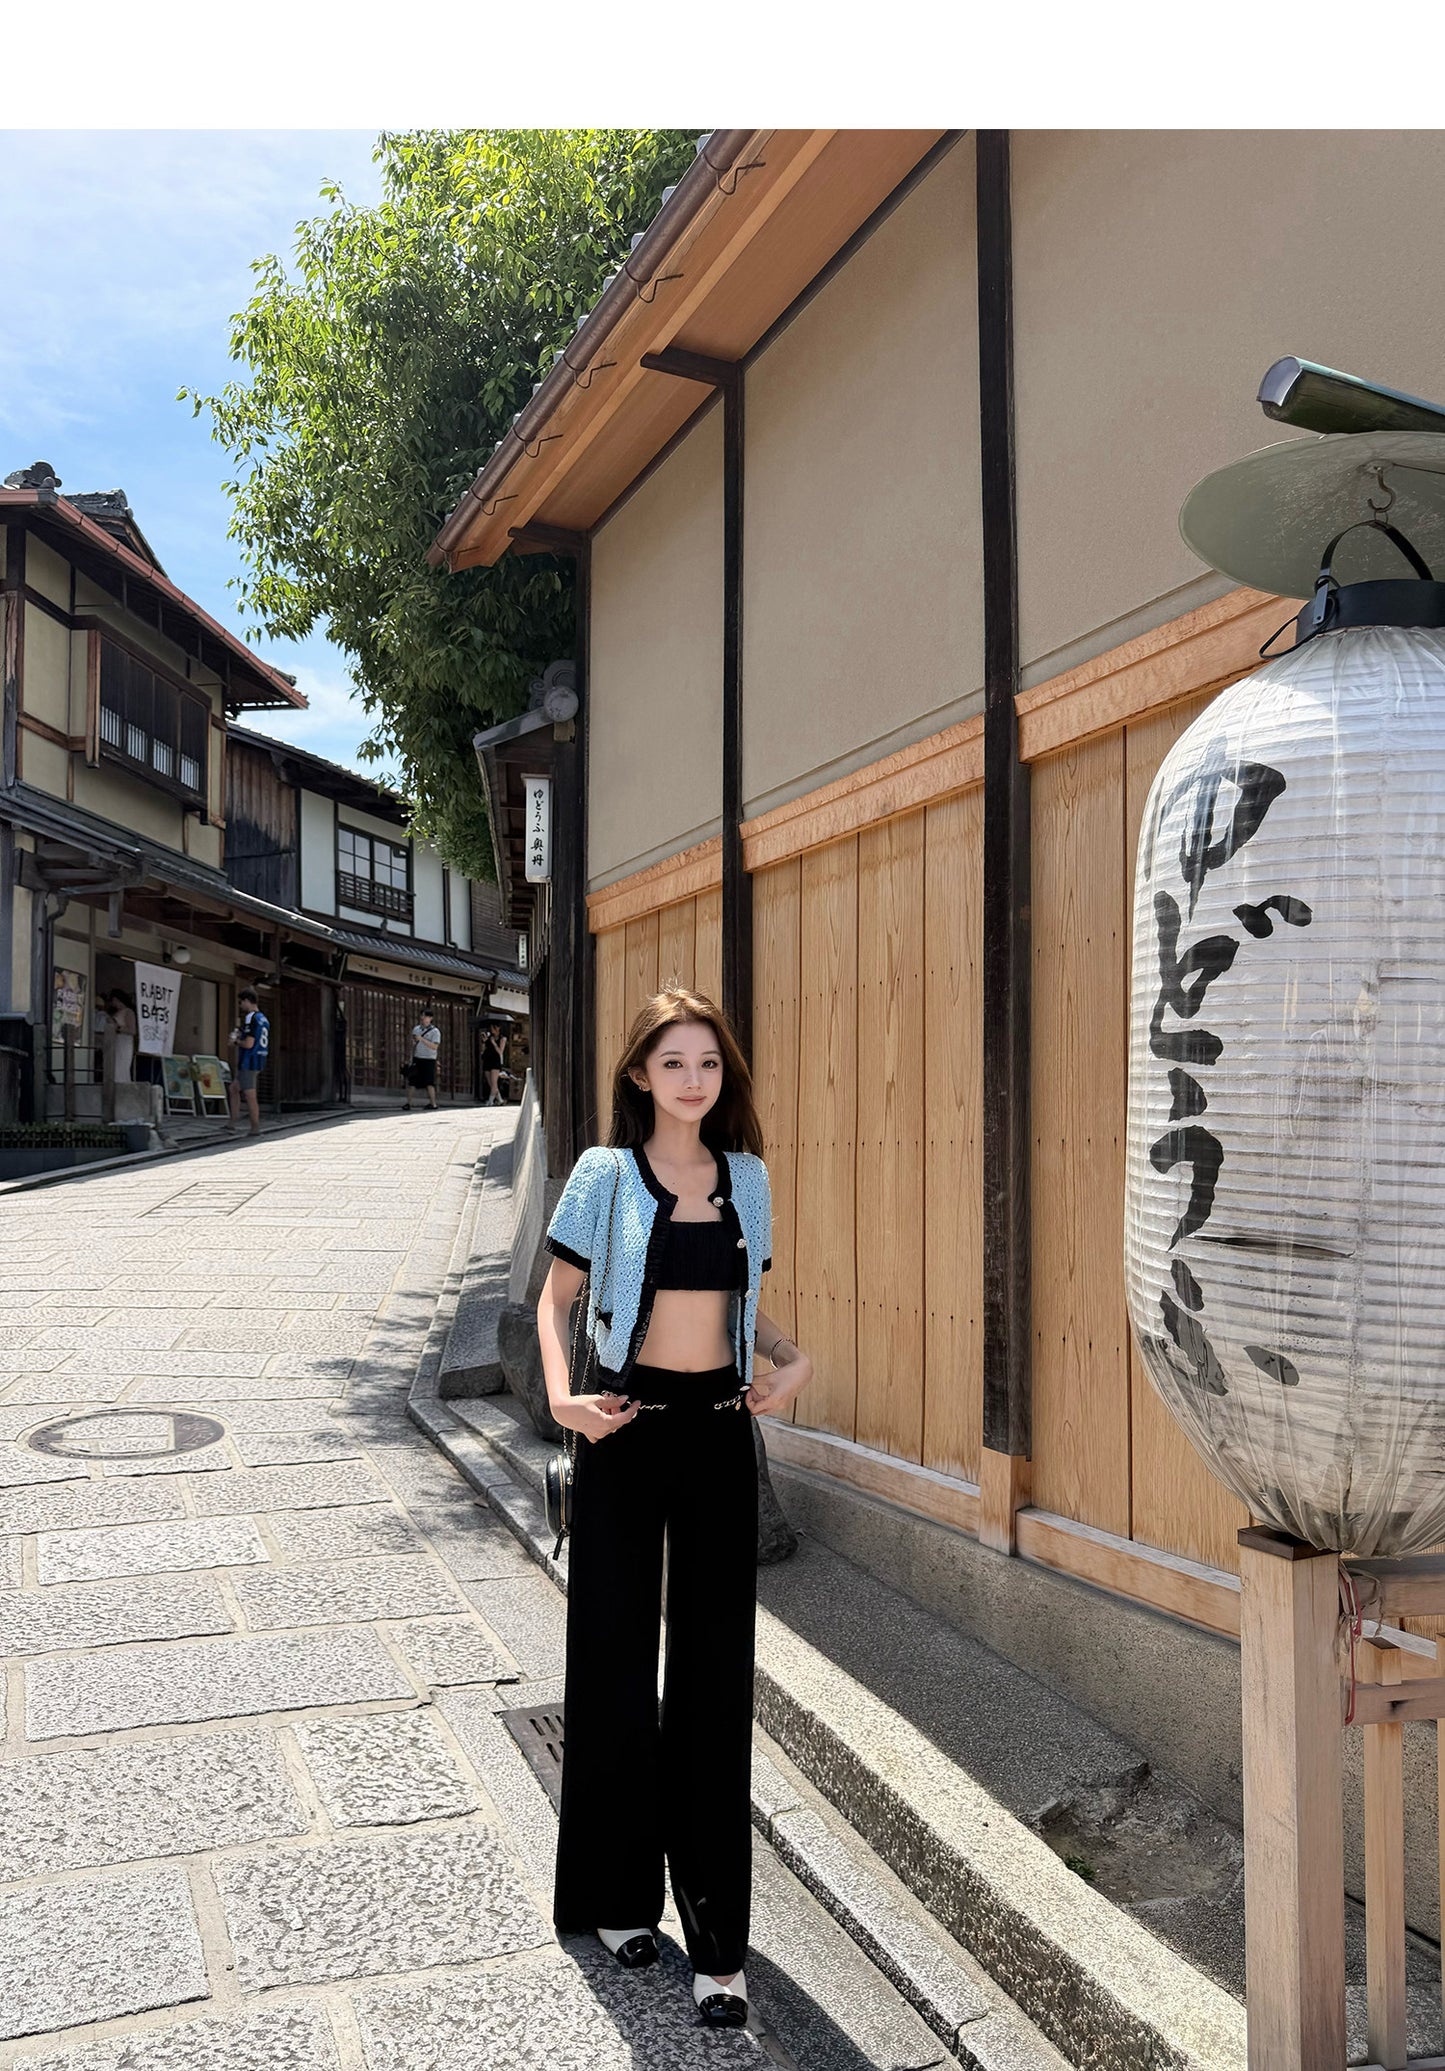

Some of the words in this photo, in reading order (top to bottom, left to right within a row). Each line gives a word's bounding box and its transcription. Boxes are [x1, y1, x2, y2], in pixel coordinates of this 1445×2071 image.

[532, 789, 545, 833] ゆどうふ
[260, 1026, 269, 1048] 8
